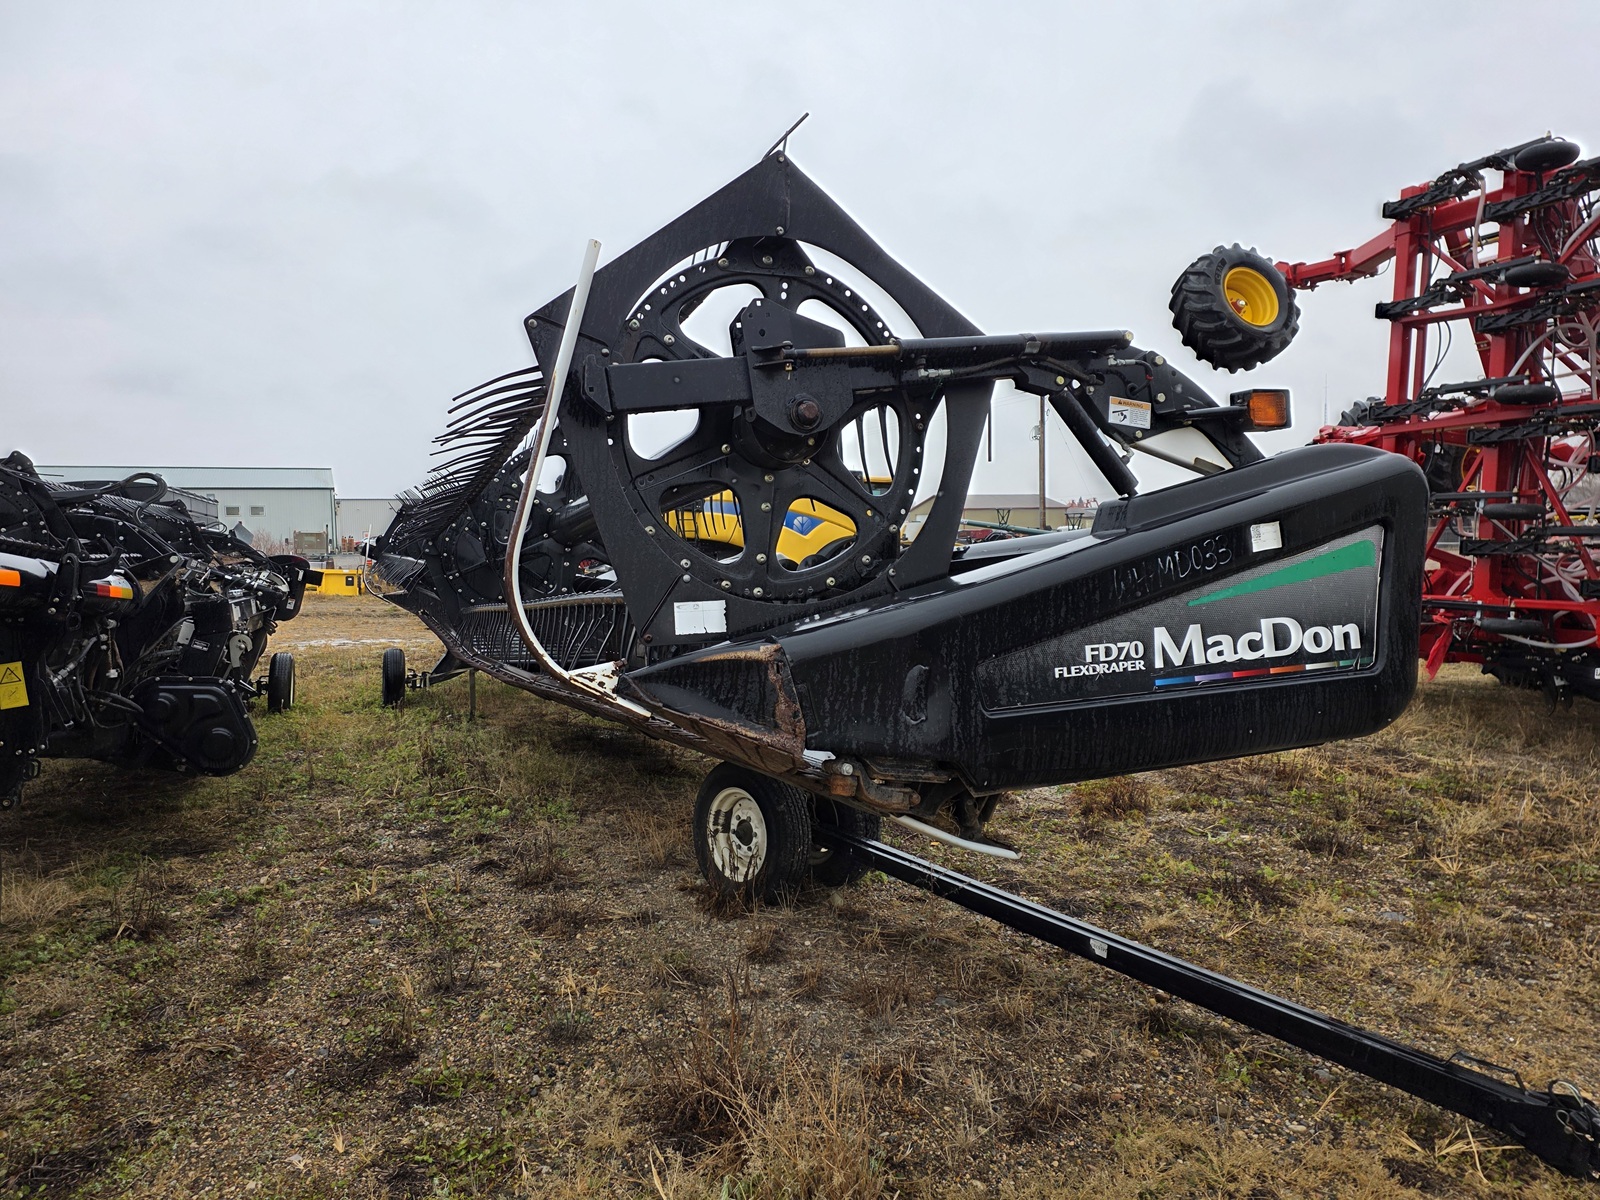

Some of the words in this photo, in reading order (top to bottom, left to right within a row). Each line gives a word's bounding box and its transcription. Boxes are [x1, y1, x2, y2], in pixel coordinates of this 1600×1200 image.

[1122, 400, 1144, 409] WARNING
[1085, 640, 1144, 662] FD70
[1153, 617, 1362, 670] MacDon
[1054, 659, 1146, 679] FLEXDRAPER
